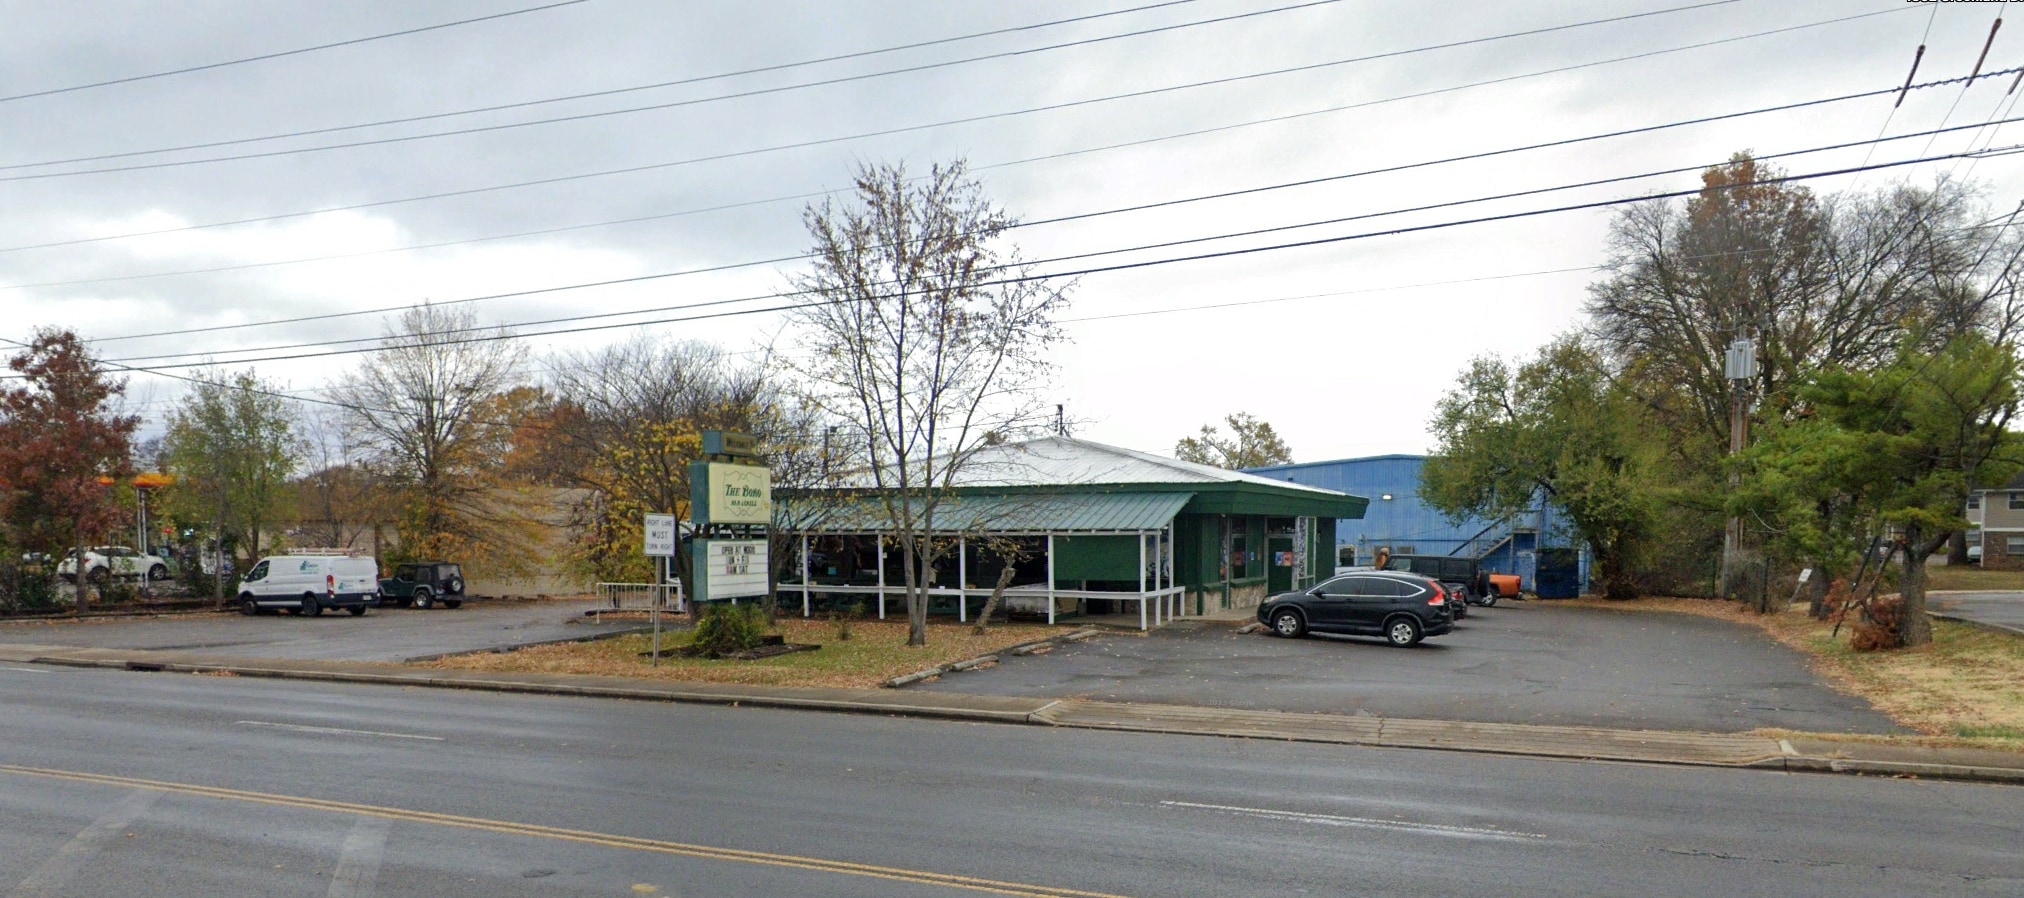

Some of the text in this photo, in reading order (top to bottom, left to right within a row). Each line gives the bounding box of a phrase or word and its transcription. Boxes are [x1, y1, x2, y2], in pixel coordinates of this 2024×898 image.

[647, 518, 673, 528] RIGHT LANE
[652, 530, 668, 540] MUST
[646, 542, 673, 551] TURN RIGHT
[721, 545, 734, 555] OPEN
